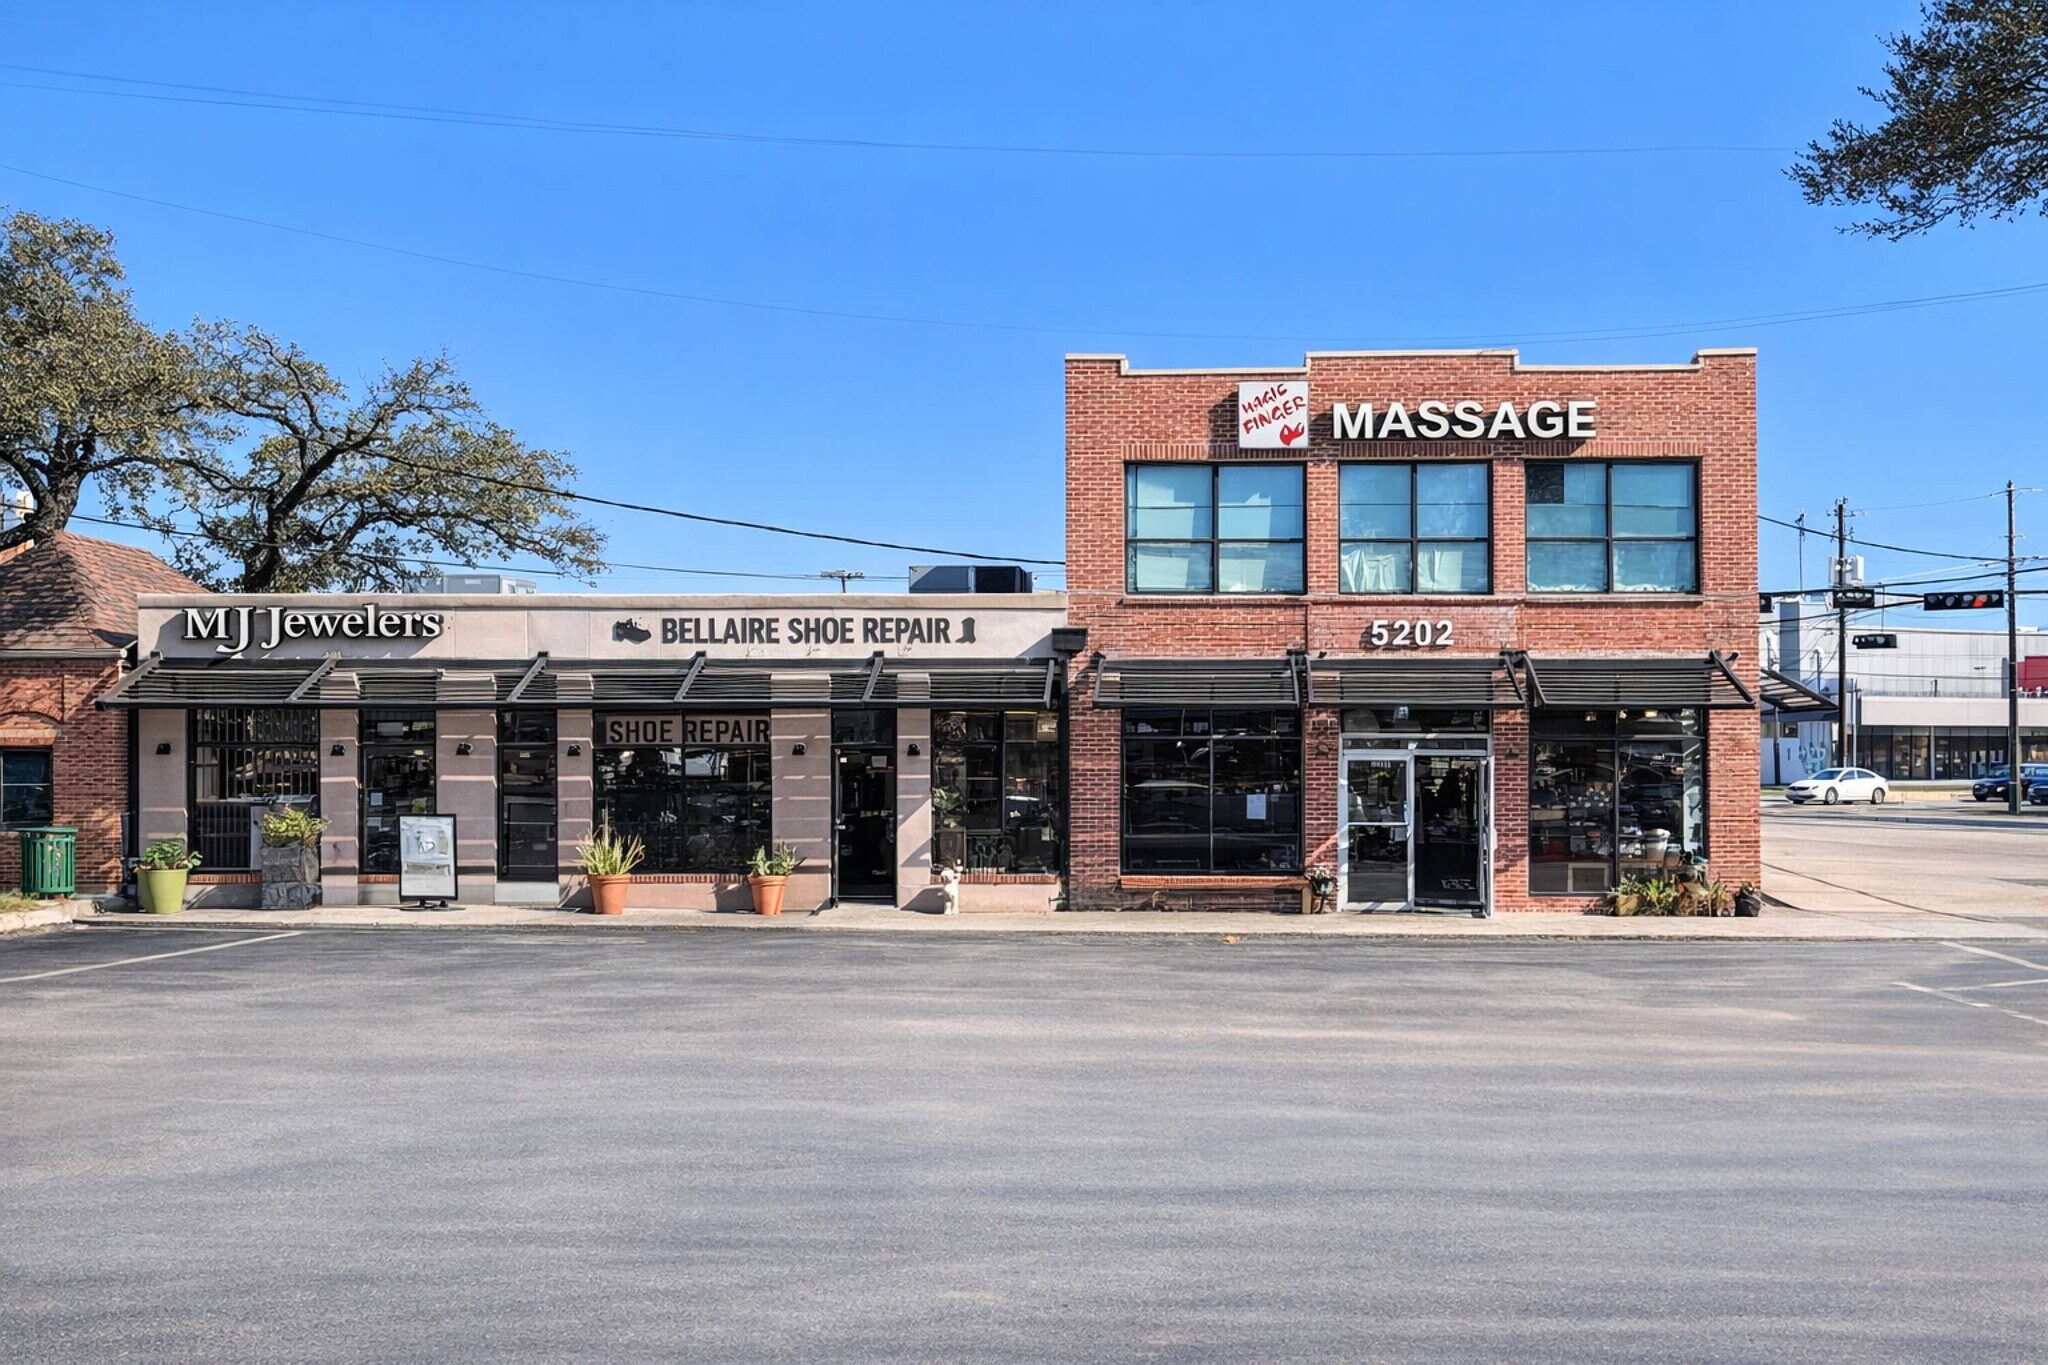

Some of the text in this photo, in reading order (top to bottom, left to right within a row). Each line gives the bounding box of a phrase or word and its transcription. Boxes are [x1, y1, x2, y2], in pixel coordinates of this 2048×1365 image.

[1241, 383, 1287, 414] MAGIC
[1243, 396, 1306, 434] FINGER
[1333, 401, 1597, 439] MASSAGE
[261, 604, 442, 650] Jewelers
[661, 618, 951, 644] BELLAIRE SHOE REPAIR
[1371, 620, 1455, 646] 5202
[609, 719, 770, 743] SHOE REPAIR
